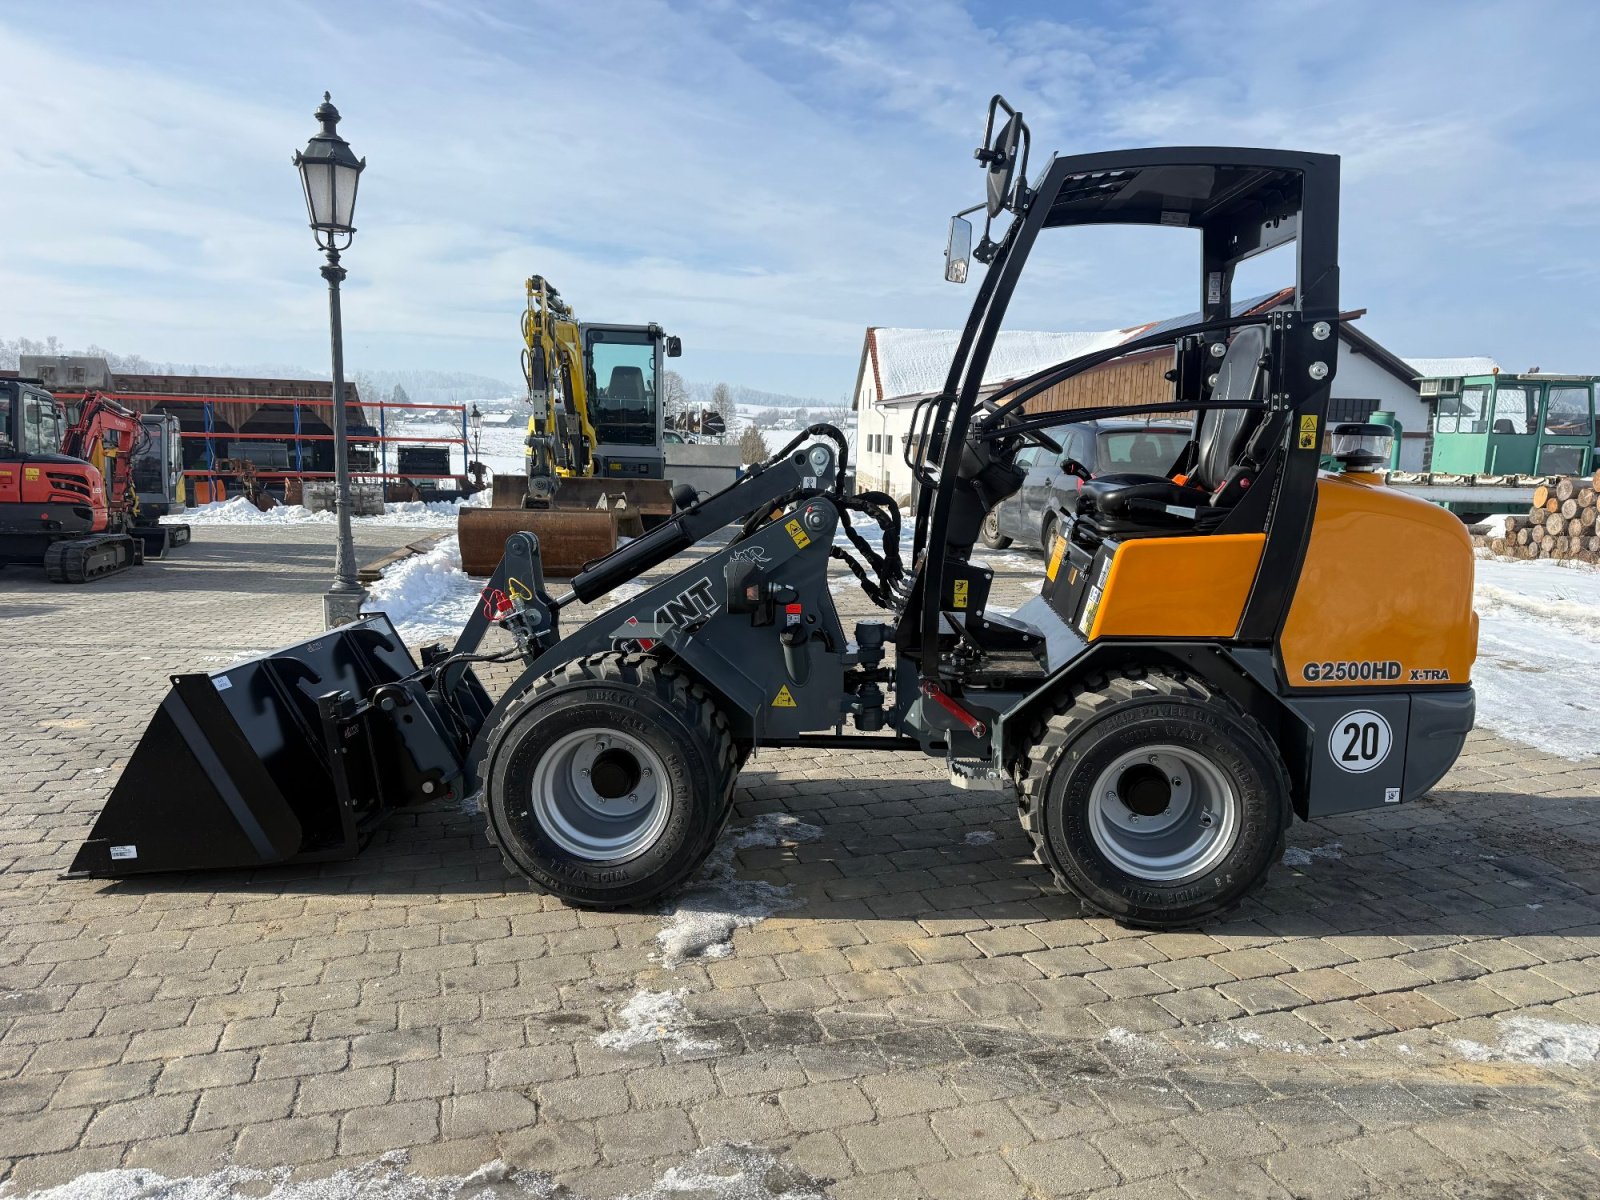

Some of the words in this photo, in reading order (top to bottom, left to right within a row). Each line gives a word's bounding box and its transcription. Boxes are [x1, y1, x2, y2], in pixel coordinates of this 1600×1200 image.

[1303, 661, 1402, 681] G2500HD
[1409, 669, 1450, 681] X-TRA
[1341, 721, 1379, 762] 20
